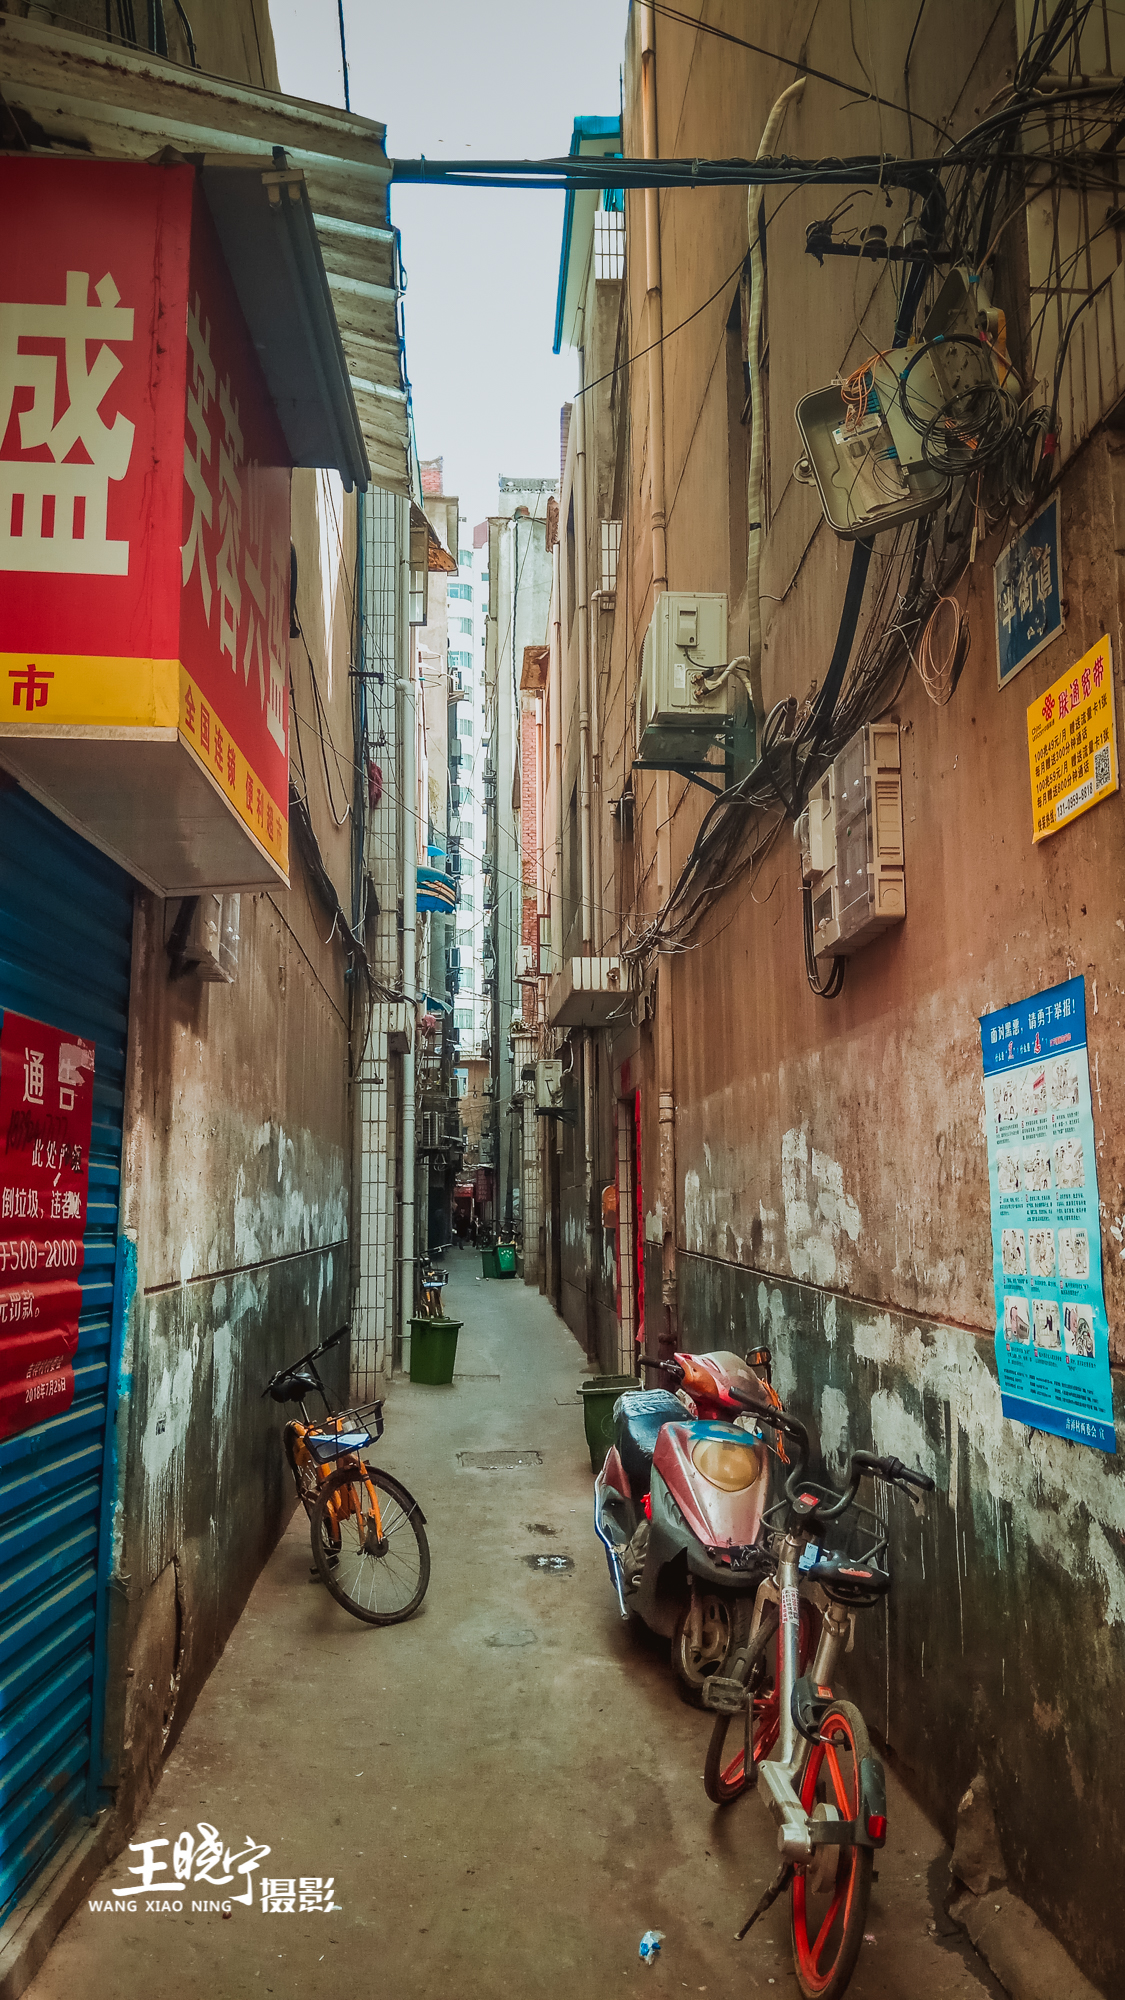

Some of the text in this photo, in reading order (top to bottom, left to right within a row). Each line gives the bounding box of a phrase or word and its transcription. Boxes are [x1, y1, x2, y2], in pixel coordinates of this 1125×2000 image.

[0, 271, 136, 576] 盛
[182, 291, 286, 759] 芙蓉兴盛
[8, 664, 54, 711] 市
[185, 684, 283, 852] 全国连锁 便利超市
